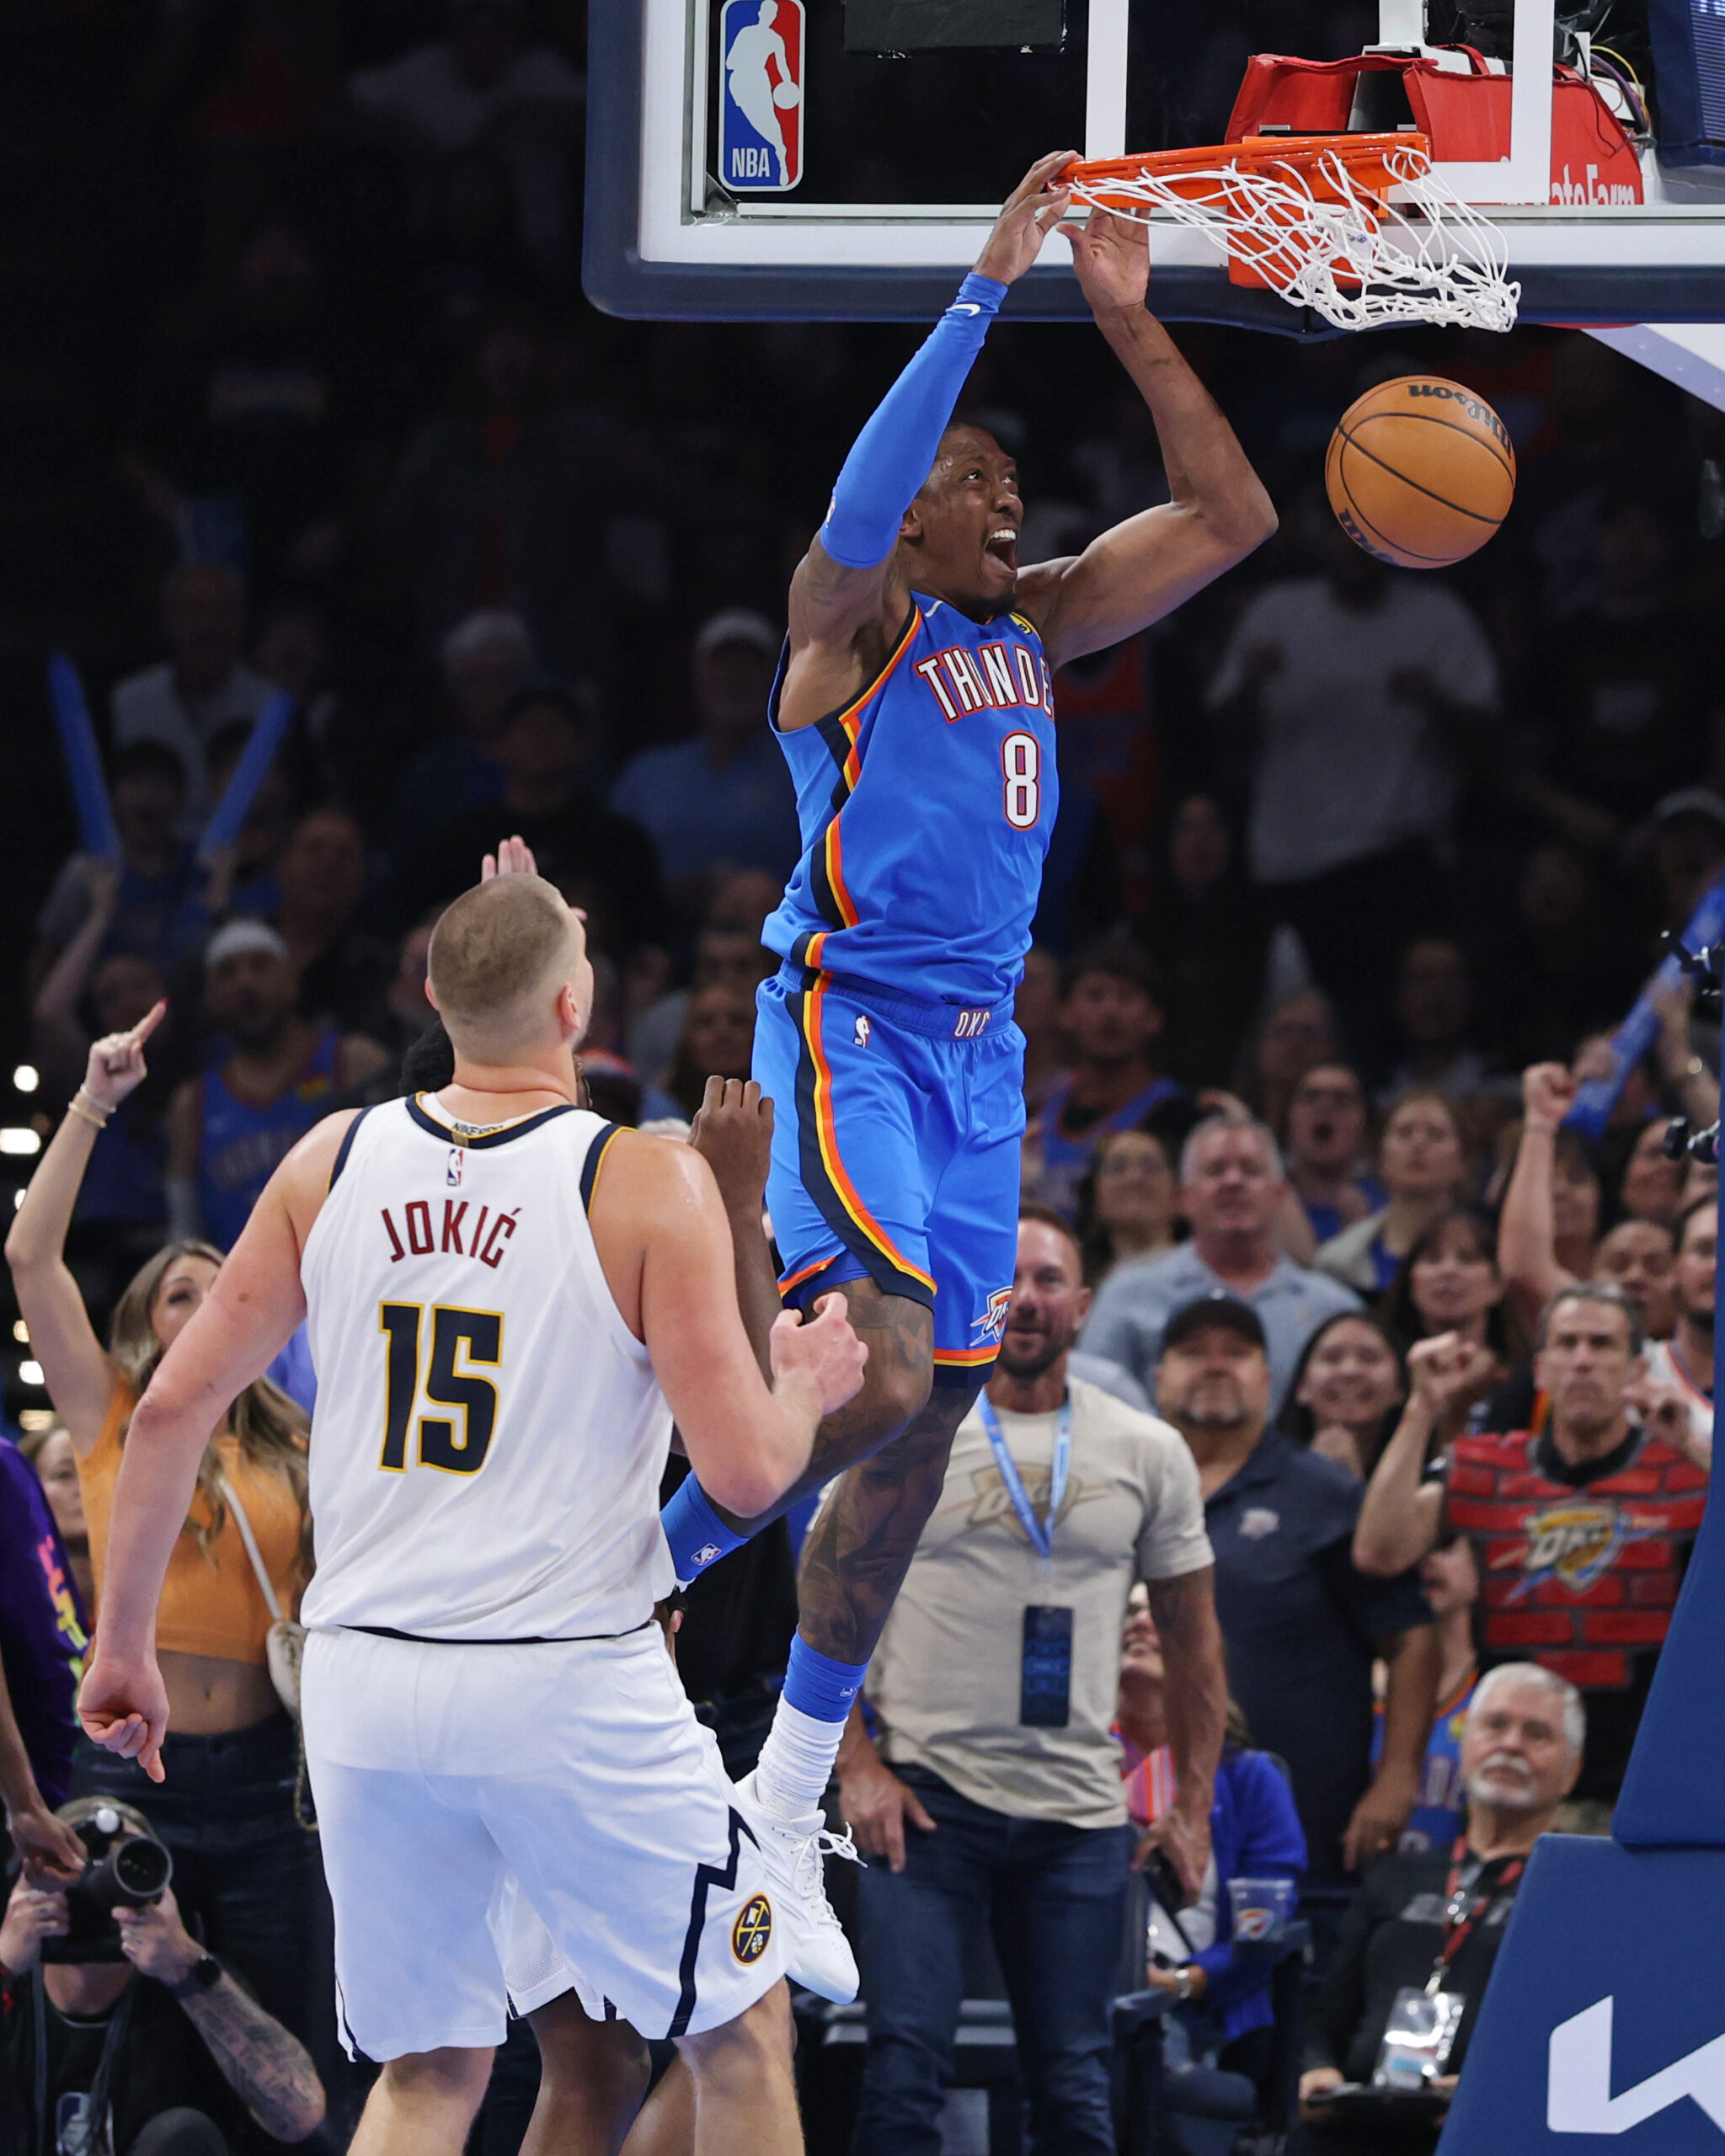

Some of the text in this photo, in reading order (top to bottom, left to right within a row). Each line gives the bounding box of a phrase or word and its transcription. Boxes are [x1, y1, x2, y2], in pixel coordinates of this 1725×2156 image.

[731, 147, 771, 178] NBA
[914, 642, 1055, 723] THUNDE
[1001, 729, 1042, 831] 8
[953, 1010, 991, 1038] OKC
[381, 1198, 522, 1269] JOKIĆ
[378, 1299, 505, 1476] 15
